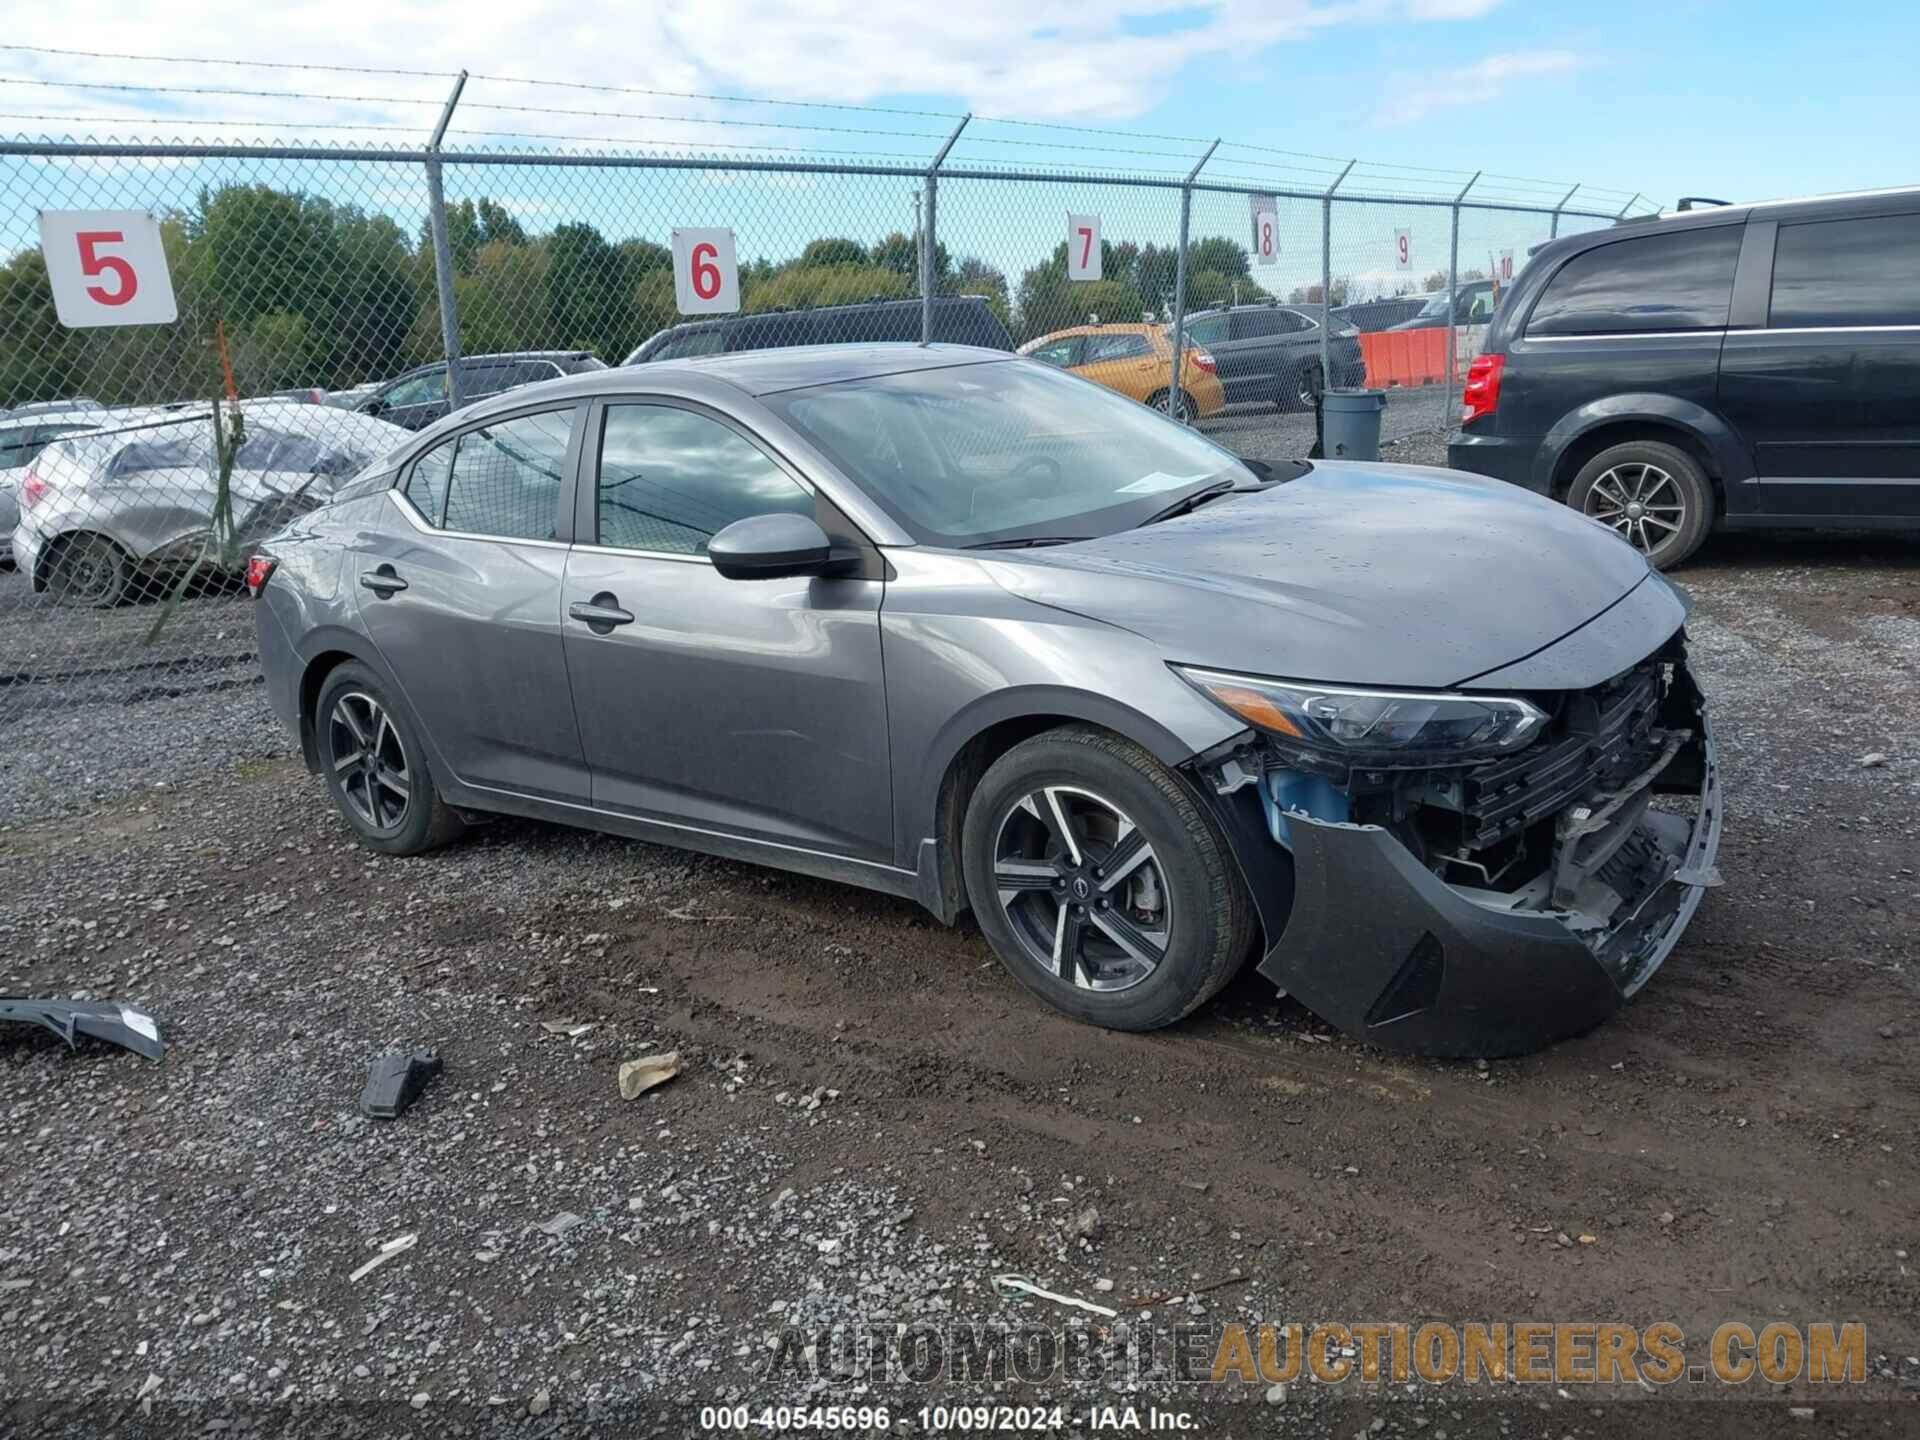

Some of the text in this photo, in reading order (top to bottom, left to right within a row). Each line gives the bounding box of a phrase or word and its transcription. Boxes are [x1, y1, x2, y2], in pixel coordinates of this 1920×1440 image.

[1077, 227, 1093, 269] 7
[1262, 222, 1272, 256] 8
[1399, 235, 1408, 264] 9
[76, 231, 137, 306] 5
[690, 242, 721, 299] 6
[1501, 256, 1513, 281] 10
